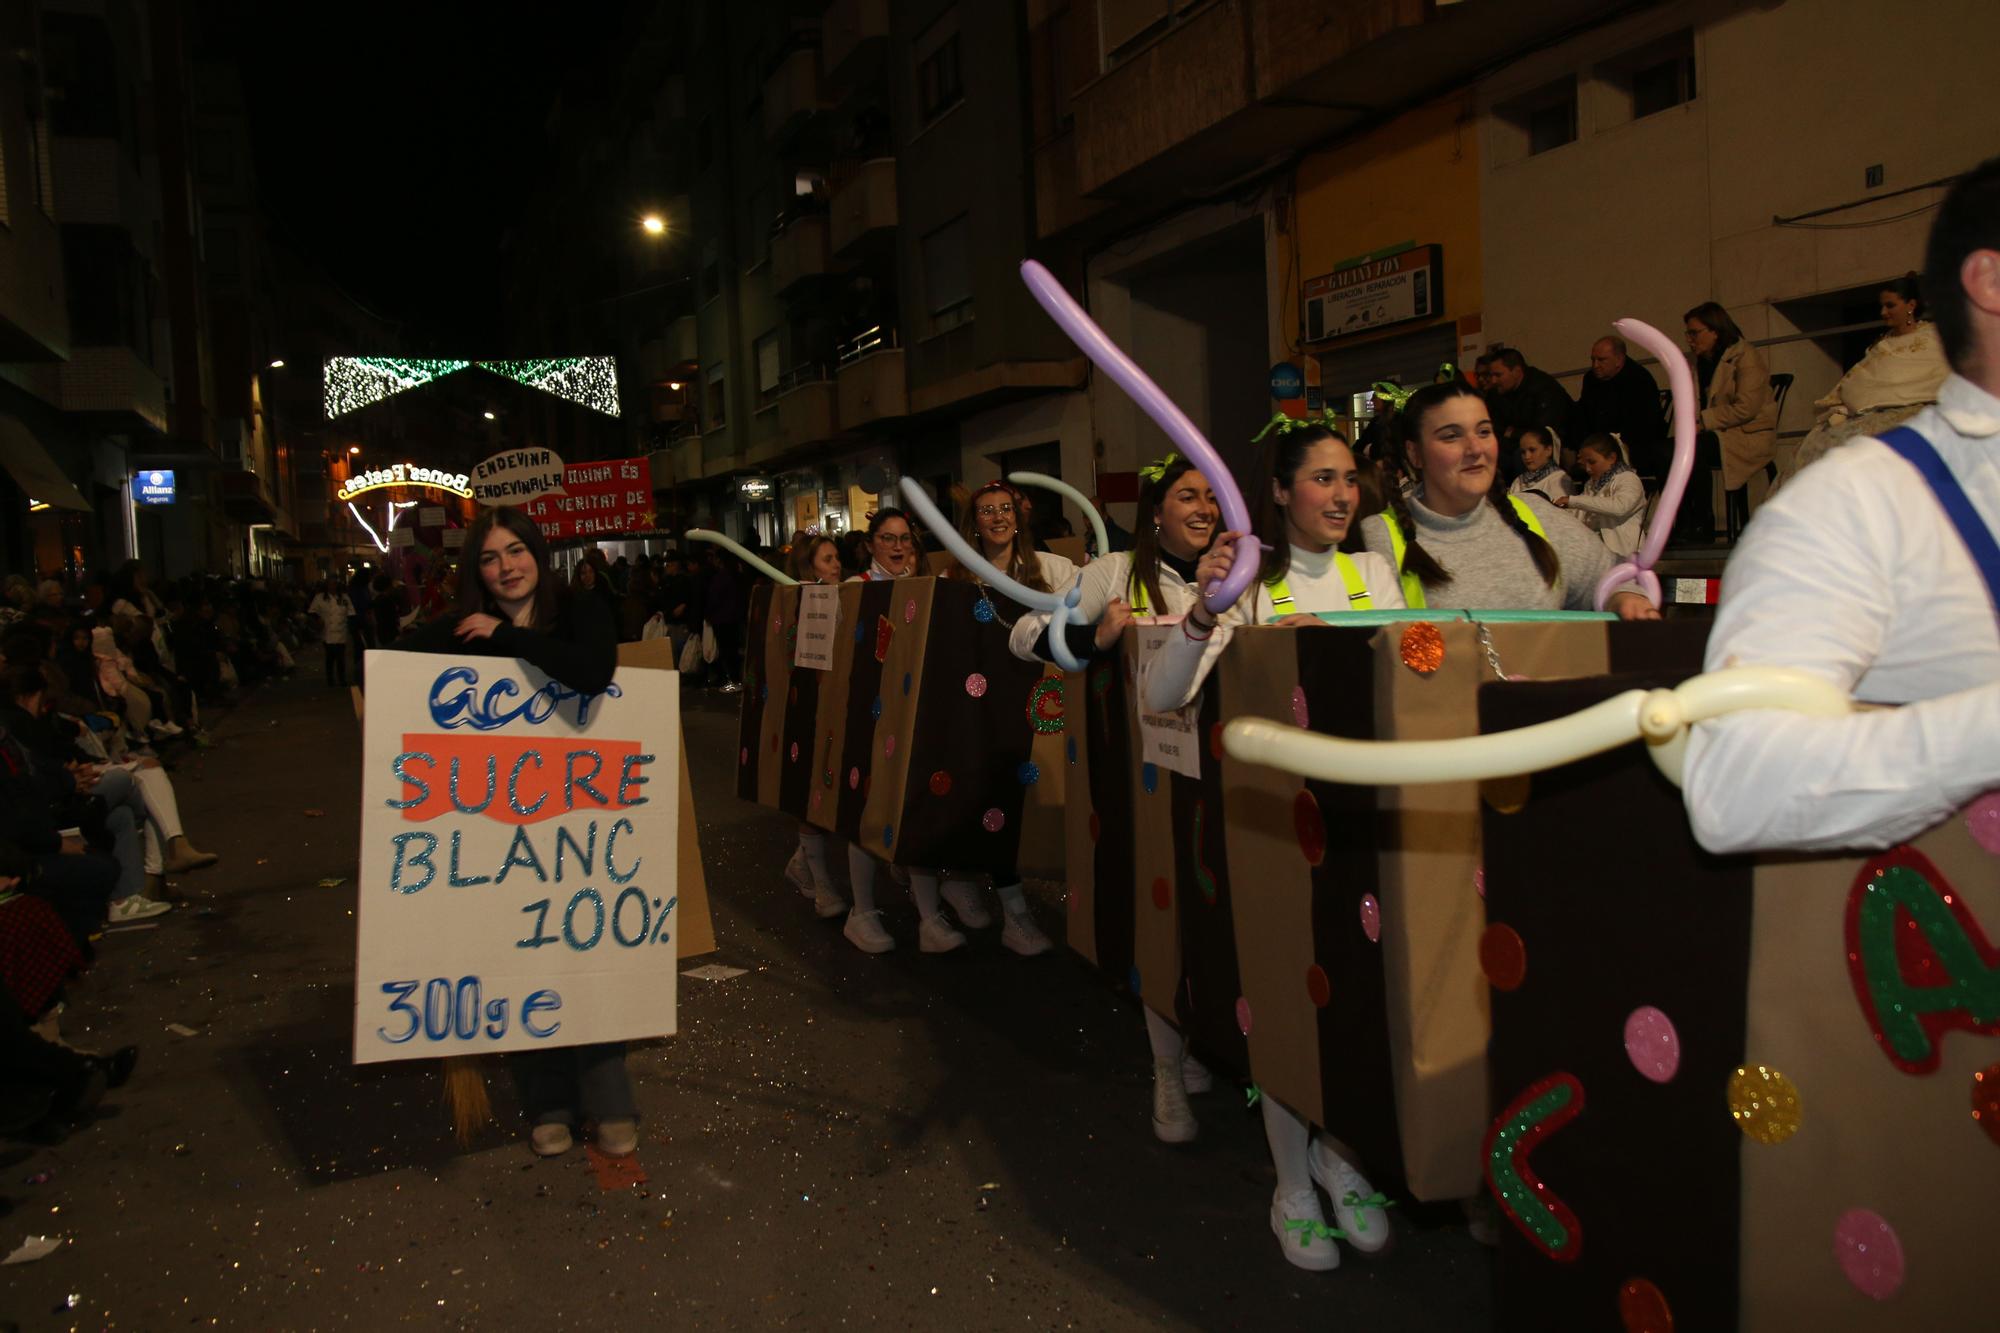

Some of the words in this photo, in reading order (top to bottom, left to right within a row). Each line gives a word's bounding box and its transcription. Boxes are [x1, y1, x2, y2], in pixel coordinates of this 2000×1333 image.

[1271, 378, 1301, 388] DIGI
[477, 451, 550, 479] ENDEVINA
[568, 466, 612, 484] QUINA
[142, 485, 173, 495] Allianz
[475, 473, 562, 499] ENDEVINALLA
[527, 501, 547, 516] LA
[556, 493, 617, 511] VERITAT
[626, 490, 646, 505] DE
[575, 511, 636, 534] FALLA?
[429, 666, 622, 732] acor
[386, 749, 655, 815] SUCRE
[391, 818, 642, 894] BLANC
[516, 886, 678, 951] 100%
